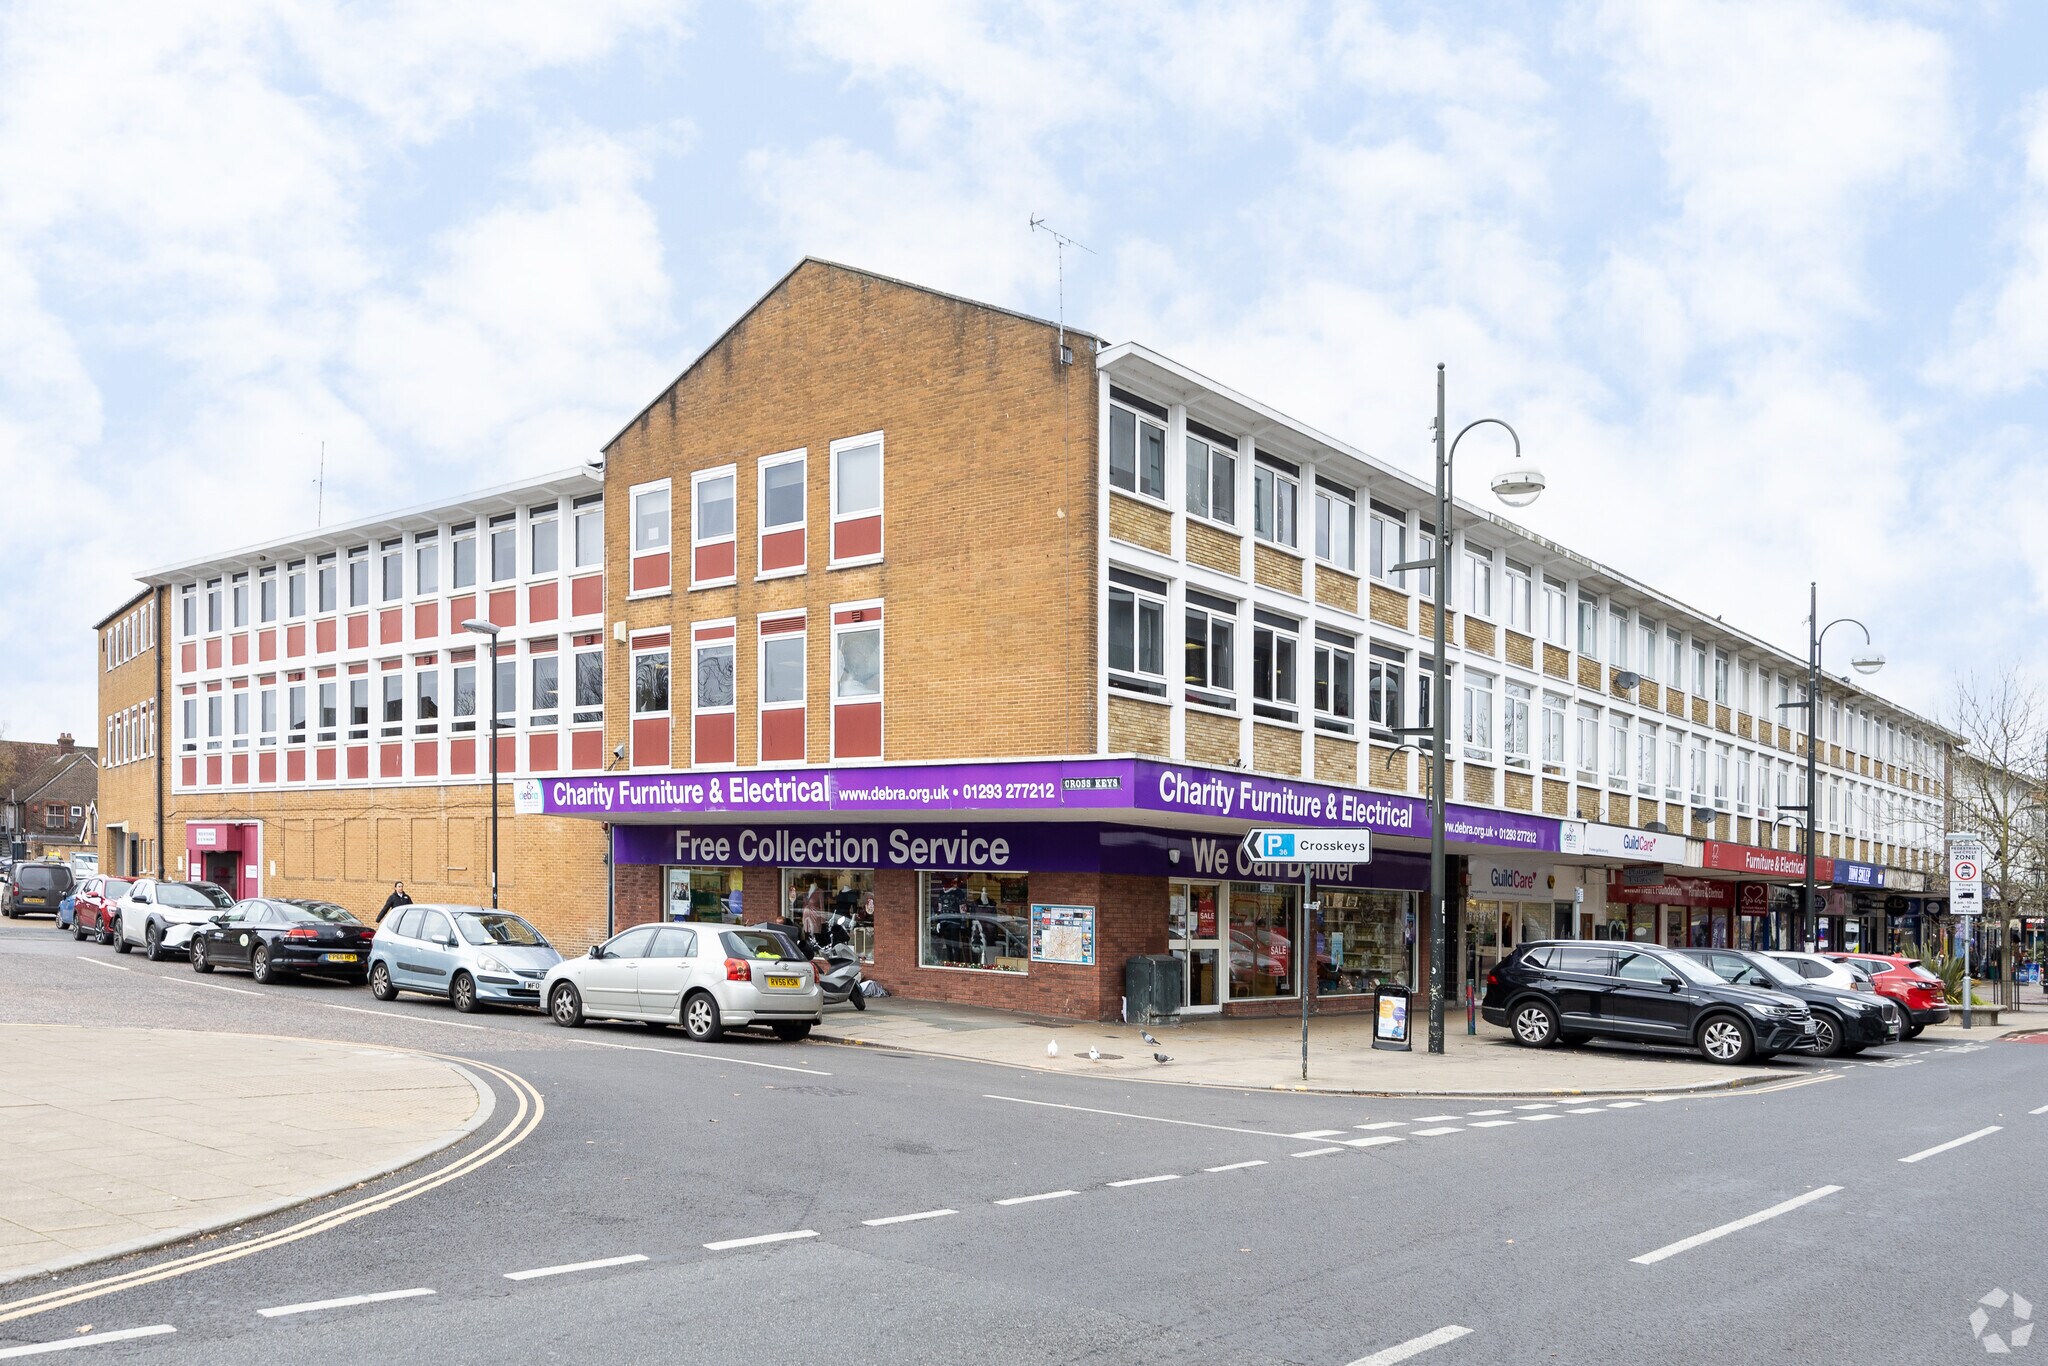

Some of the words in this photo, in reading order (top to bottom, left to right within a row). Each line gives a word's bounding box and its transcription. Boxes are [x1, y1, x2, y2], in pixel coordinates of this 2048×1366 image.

[553, 781, 614, 810] Charity
[619, 779, 704, 804] Furniture
[708, 780, 723, 803] &
[729, 775, 830, 803] Electrical
[839, 784, 949, 804] www.debra.org.uk
[963, 784, 1001, 800] 01293
[1005, 783, 1055, 799] 277212
[1065, 780, 1091, 788] CROSS
[1095, 779, 1118, 788] KEYS
[1159, 771, 1234, 814] Charity
[1240, 782, 1321, 819] Furniture
[1325, 793, 1338, 820] &
[1342, 795, 1412, 828] Electrical
[1445, 821, 1494, 839] ww.debra.org.uk
[1499, 827, 1516, 840] 01293
[1517, 830, 1537, 843] 277212
[676, 830, 730, 861] Free
[738, 830, 878, 863] Collection
[889, 829, 1010, 865] Service
[1268, 836, 1282, 855] P
[1300, 840, 1365, 853] Crosskeys
[1191, 838, 1228, 875] We
[1745, 851, 1774, 871] Furniture
[1775, 856, 1780, 872] &
[1780, 856, 1806, 875] Electrical
[1200, 912, 1215, 920] SALE
[1270, 946, 1287, 955] SALE
[770, 977, 786, 986] RV56
